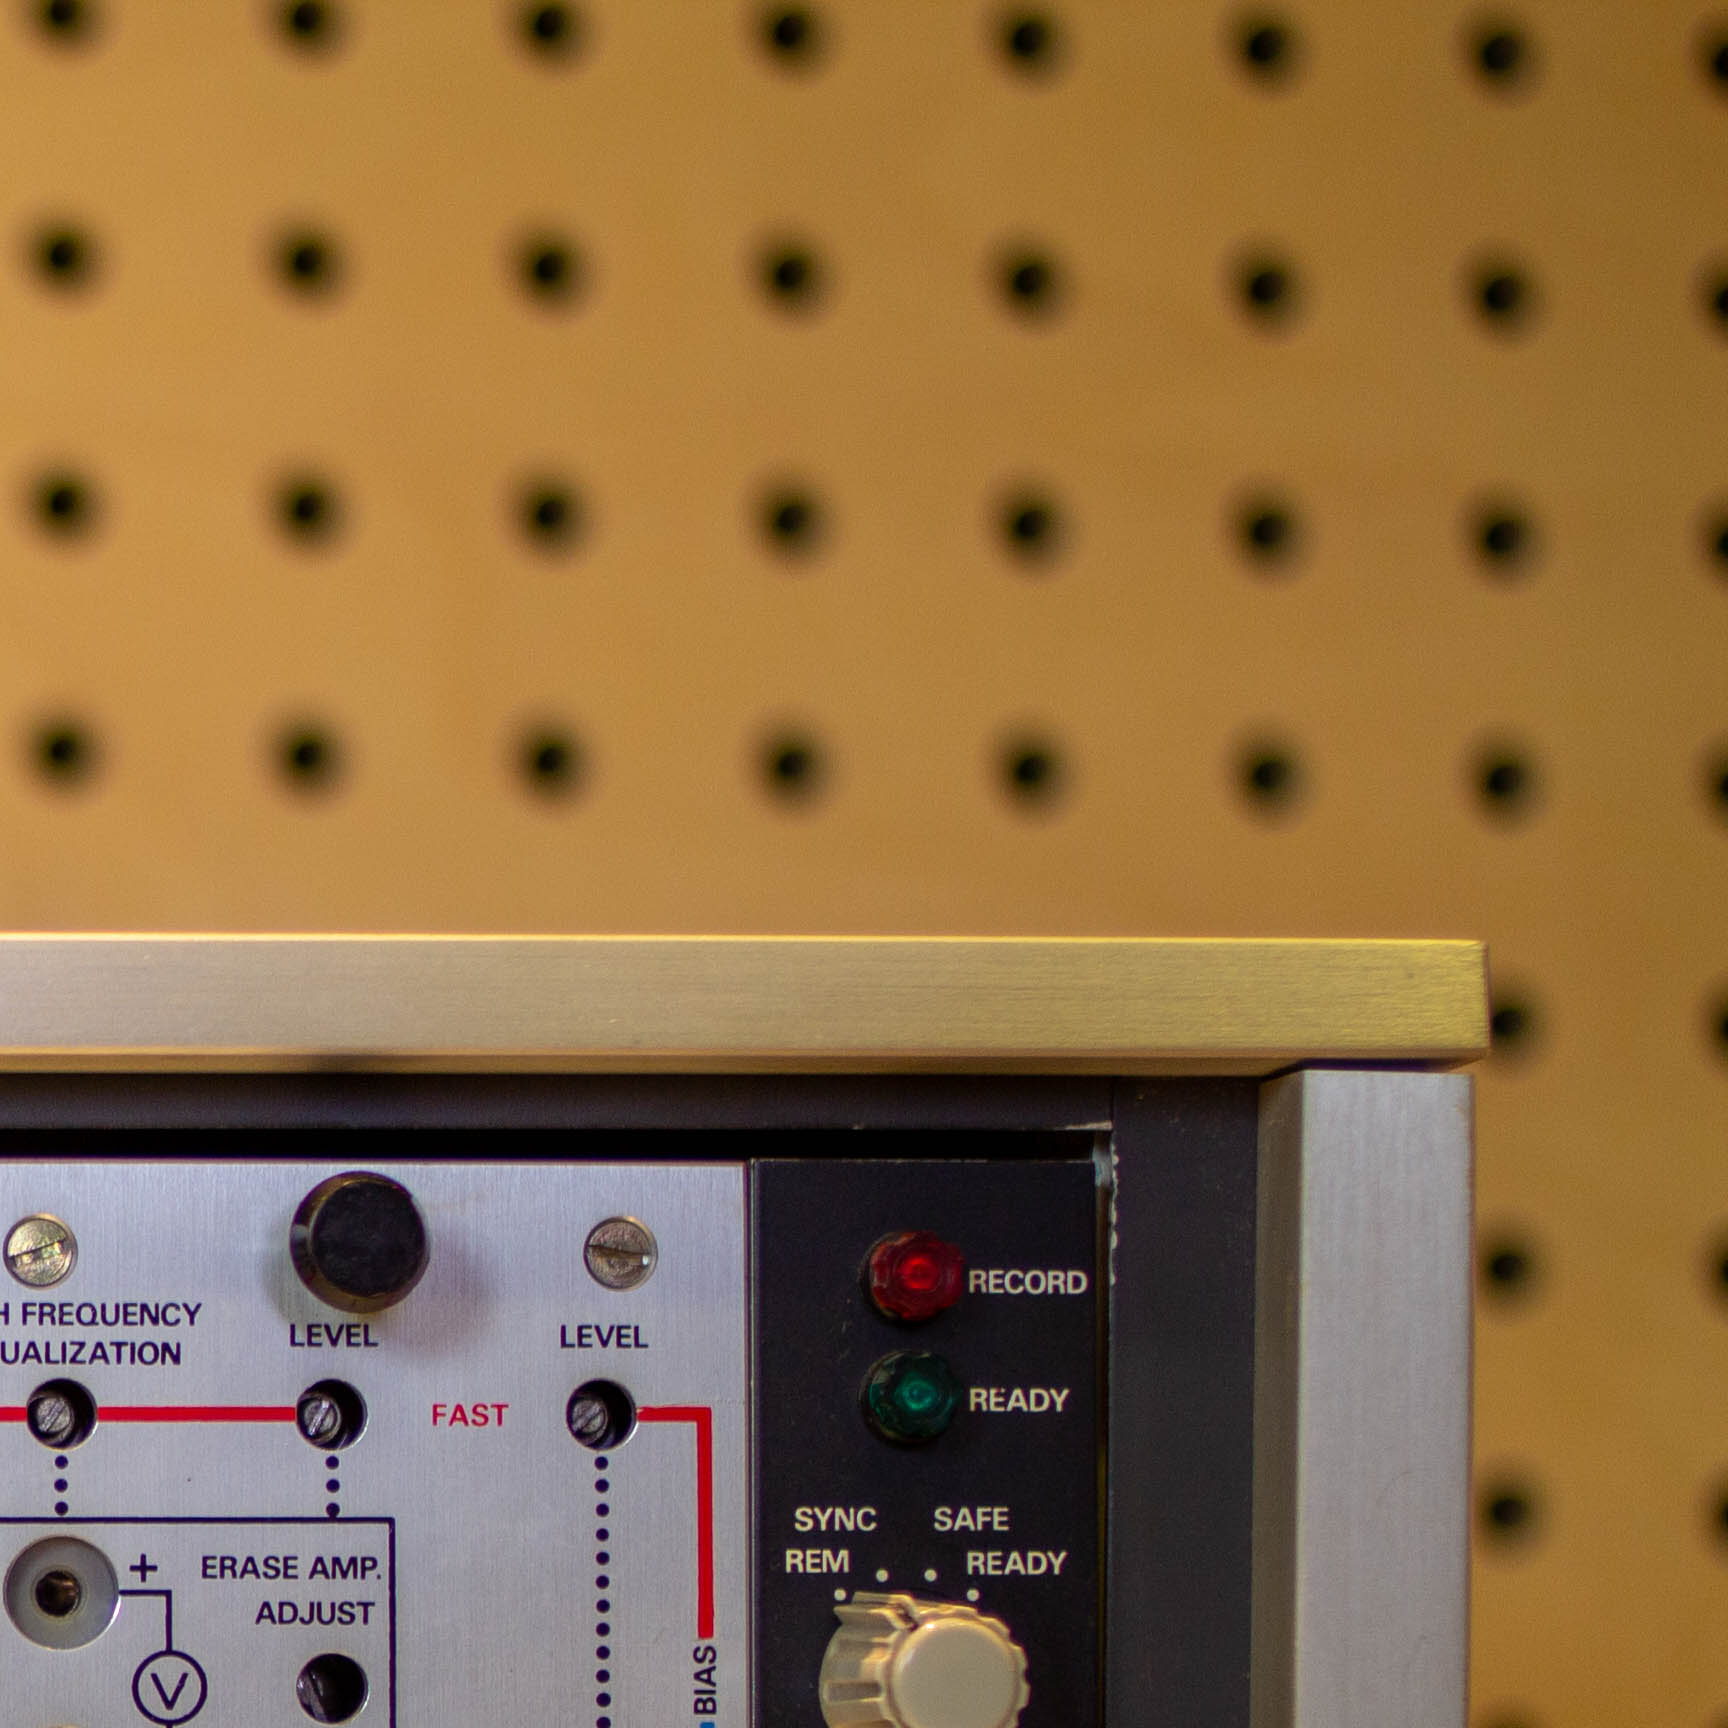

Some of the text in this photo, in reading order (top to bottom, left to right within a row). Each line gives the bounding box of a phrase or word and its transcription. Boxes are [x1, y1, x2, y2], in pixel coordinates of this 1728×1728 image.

[969, 1269, 1088, 1295] RECORD
[21, 1302, 202, 1327] FREQUENCY
[289, 1324, 378, 1348] LEVEL
[560, 1324, 649, 1349] LEVEL
[969, 1387, 1070, 1413] READY
[432, 1403, 509, 1427] FAST
[794, 1506, 1010, 1532] SYNC SAFE
[201, 1555, 382, 1580] ERASE AMP.
[785, 1549, 1067, 1576] REM READY
[255, 1600, 376, 1626] ADJUST
[151, 1673, 190, 1708] V
[692, 1645, 717, 1715] BIAS
